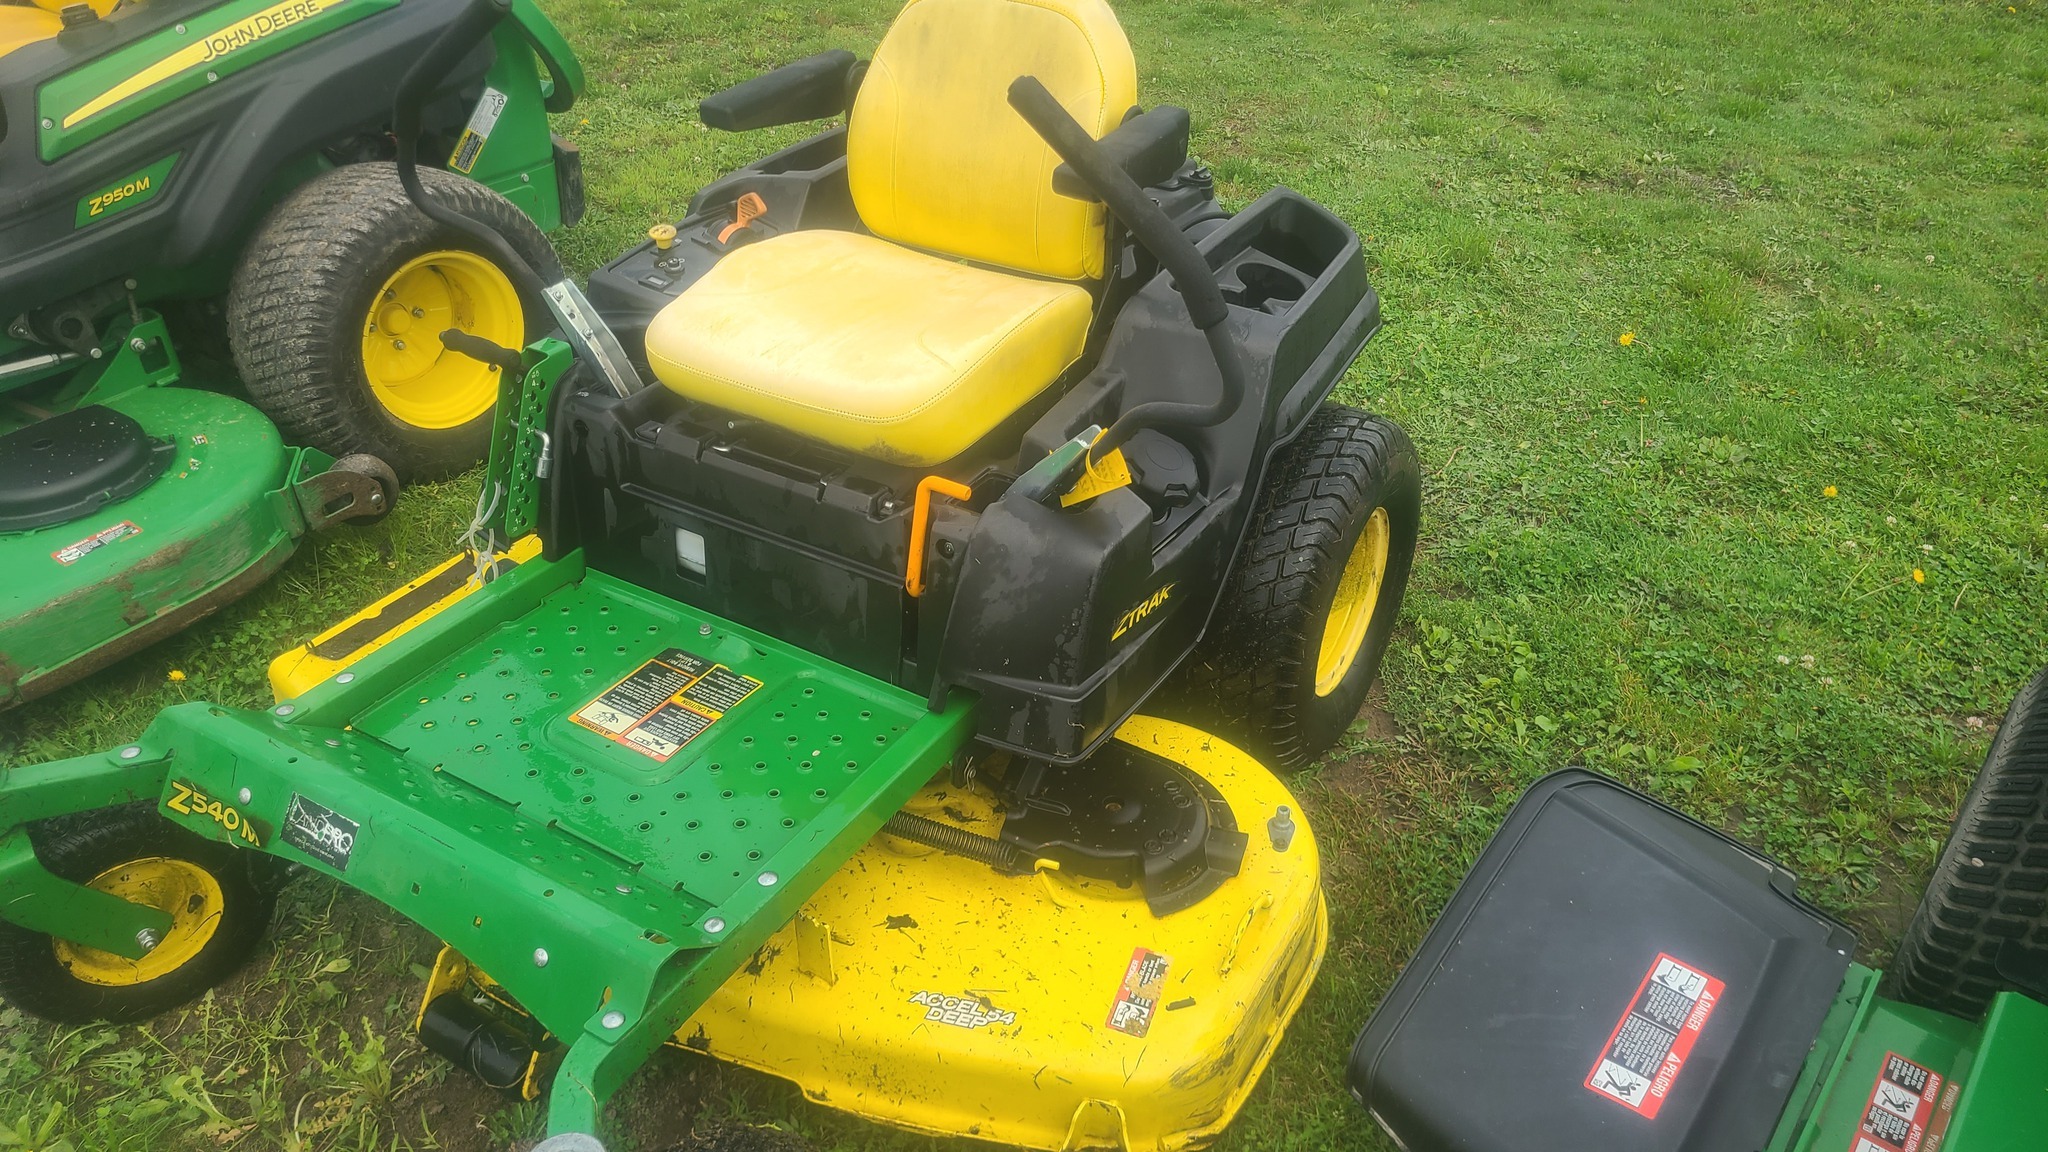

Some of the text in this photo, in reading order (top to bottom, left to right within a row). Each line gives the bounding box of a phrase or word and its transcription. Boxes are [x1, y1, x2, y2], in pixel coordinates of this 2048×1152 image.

[204, 0, 320, 60] JOHN DEERE
[1111, 584, 1176, 642] ZTRAK
[682, 699, 709, 714] CAUTION
[577, 718, 605, 735] WARNING
[909, 990, 985, 1017] ACCEL
[1685, 998, 1711, 1031] DANGER
[925, 1006, 988, 1030] DEEP
[986, 1008, 1017, 1026] 54
[1649, 1061, 1678, 1098] PELIGRO
[1924, 1079, 1939, 1102] DANGER
